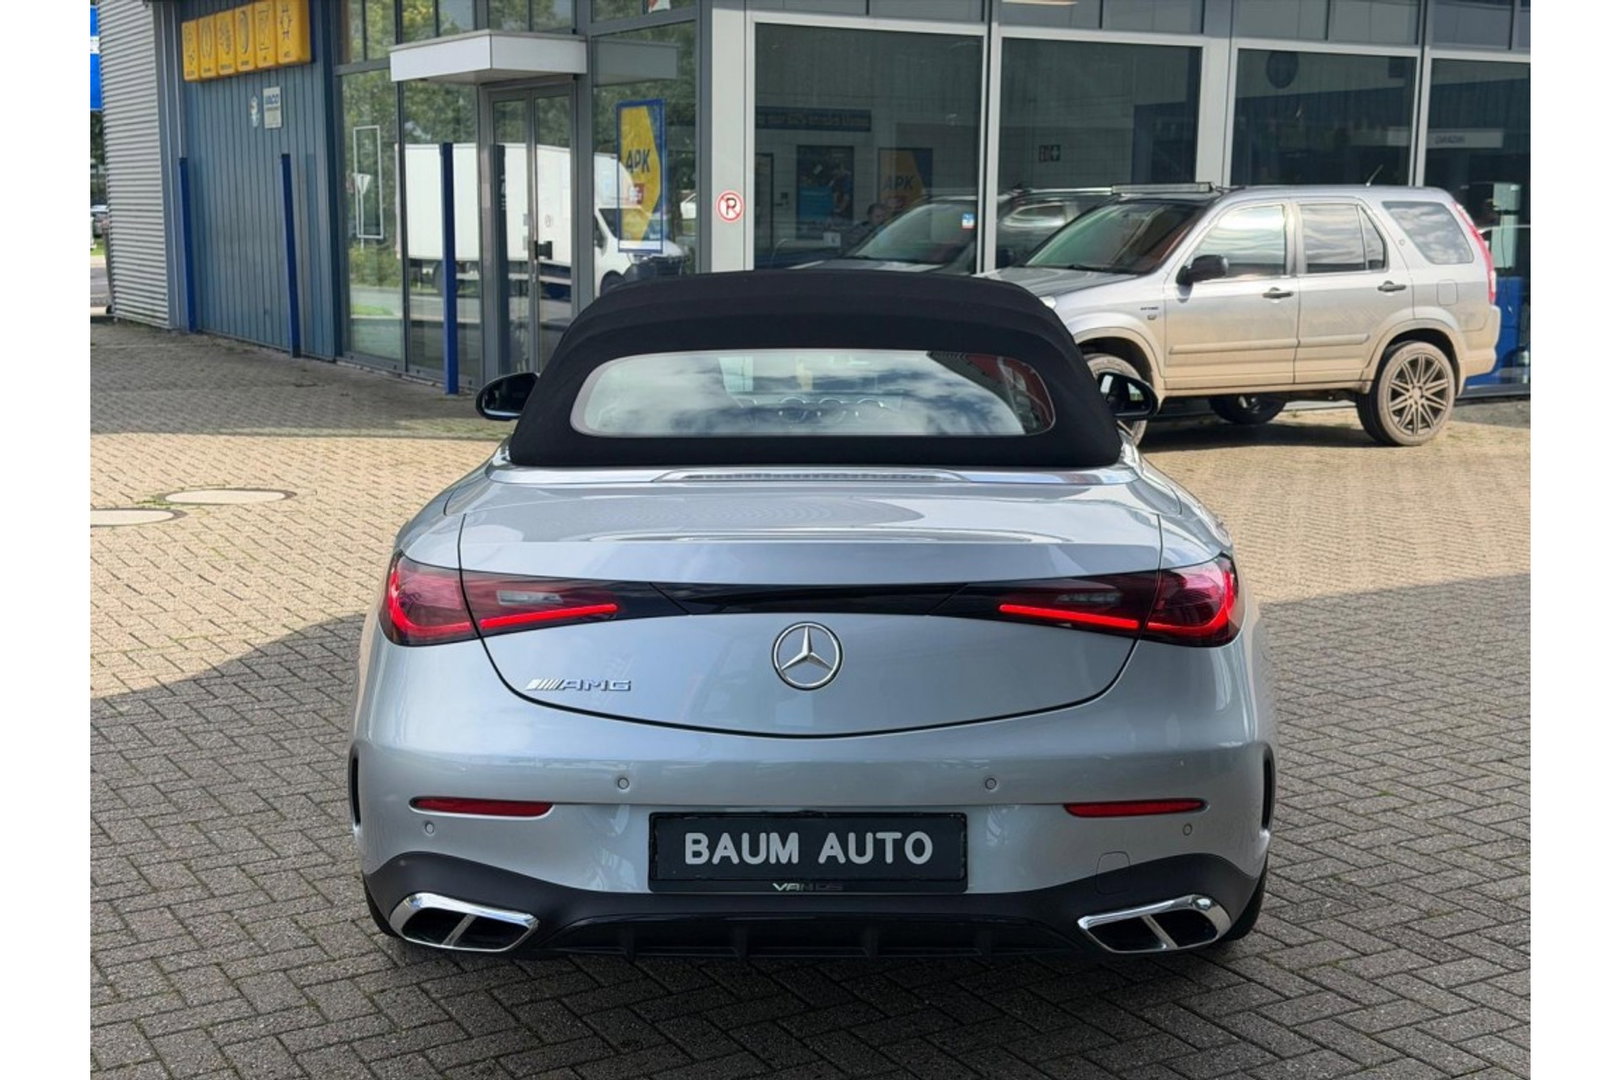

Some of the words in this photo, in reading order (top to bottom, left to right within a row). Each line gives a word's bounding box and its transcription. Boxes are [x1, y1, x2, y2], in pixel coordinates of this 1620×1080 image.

[626, 149, 651, 174] APK
[882, 175, 914, 191] APK
[560, 679, 632, 692] AMG
[684, 832, 800, 865] BAUM
[817, 831, 934, 865] AUTO
